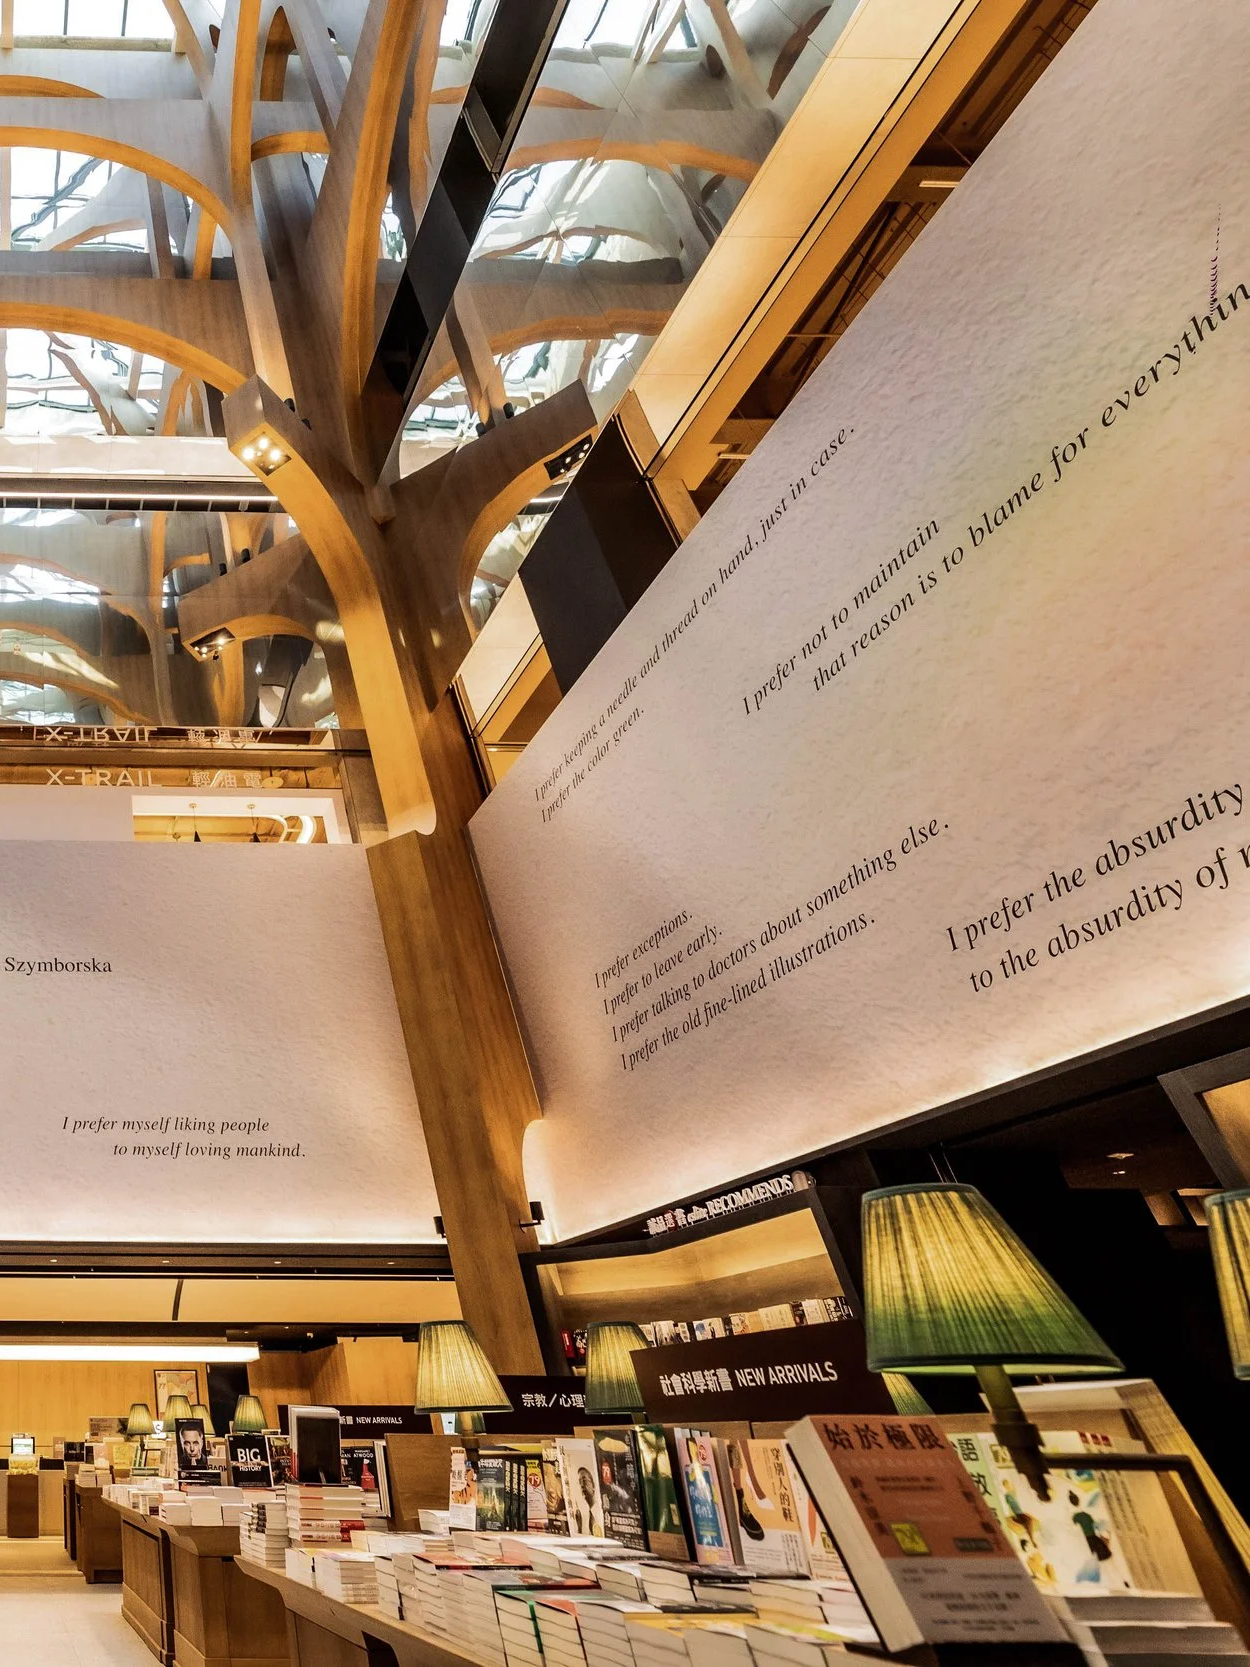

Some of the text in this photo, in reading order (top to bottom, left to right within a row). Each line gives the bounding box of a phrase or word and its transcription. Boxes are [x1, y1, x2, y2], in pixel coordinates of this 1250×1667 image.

[813, 651, 848, 692] that
[850, 592, 915, 658] reason
[917, 570, 938, 595] is
[941, 546, 964, 574] to
[966, 472, 1045, 548] blame
[1049, 427, 1089, 484] for
[534, 428, 855, 802] I prefer keeping a needle and thread on hand, just in case.
[46, 769, 162, 787] X-TRAIL
[541, 707, 645, 823] I prefer the color green.
[945, 925, 959, 952] I
[962, 892, 1035, 951] prefer
[1042, 867, 1087, 903] the
[1095, 783, 1243, 876] absurdity
[612, 818, 949, 1042] I prefer talking to doctors about something else.
[4, 956, 112, 976] Szymborska
[594, 910, 693, 989] I prefer exceptions.
[622, 913, 875, 1072] I prefer the old fine-lined illustrations.
[62, 1116, 270, 1135] I prefer myself liking people
[113, 1141, 306, 1161] to myself loving mankind.
[706, 1175, 794, 1215] RECOMMENDS
[659, 1361, 839, 1397] 社會科學新書 NEW ARRIVALS
[521, 1393, 586, 1408] 宗教／心理
[355, 1416, 372, 1424] NEW
[372, 1416, 403, 1424] ARRIVALS
[823, 1422, 946, 1451] 始於極限
[237, 1448, 261, 1463] BIG
